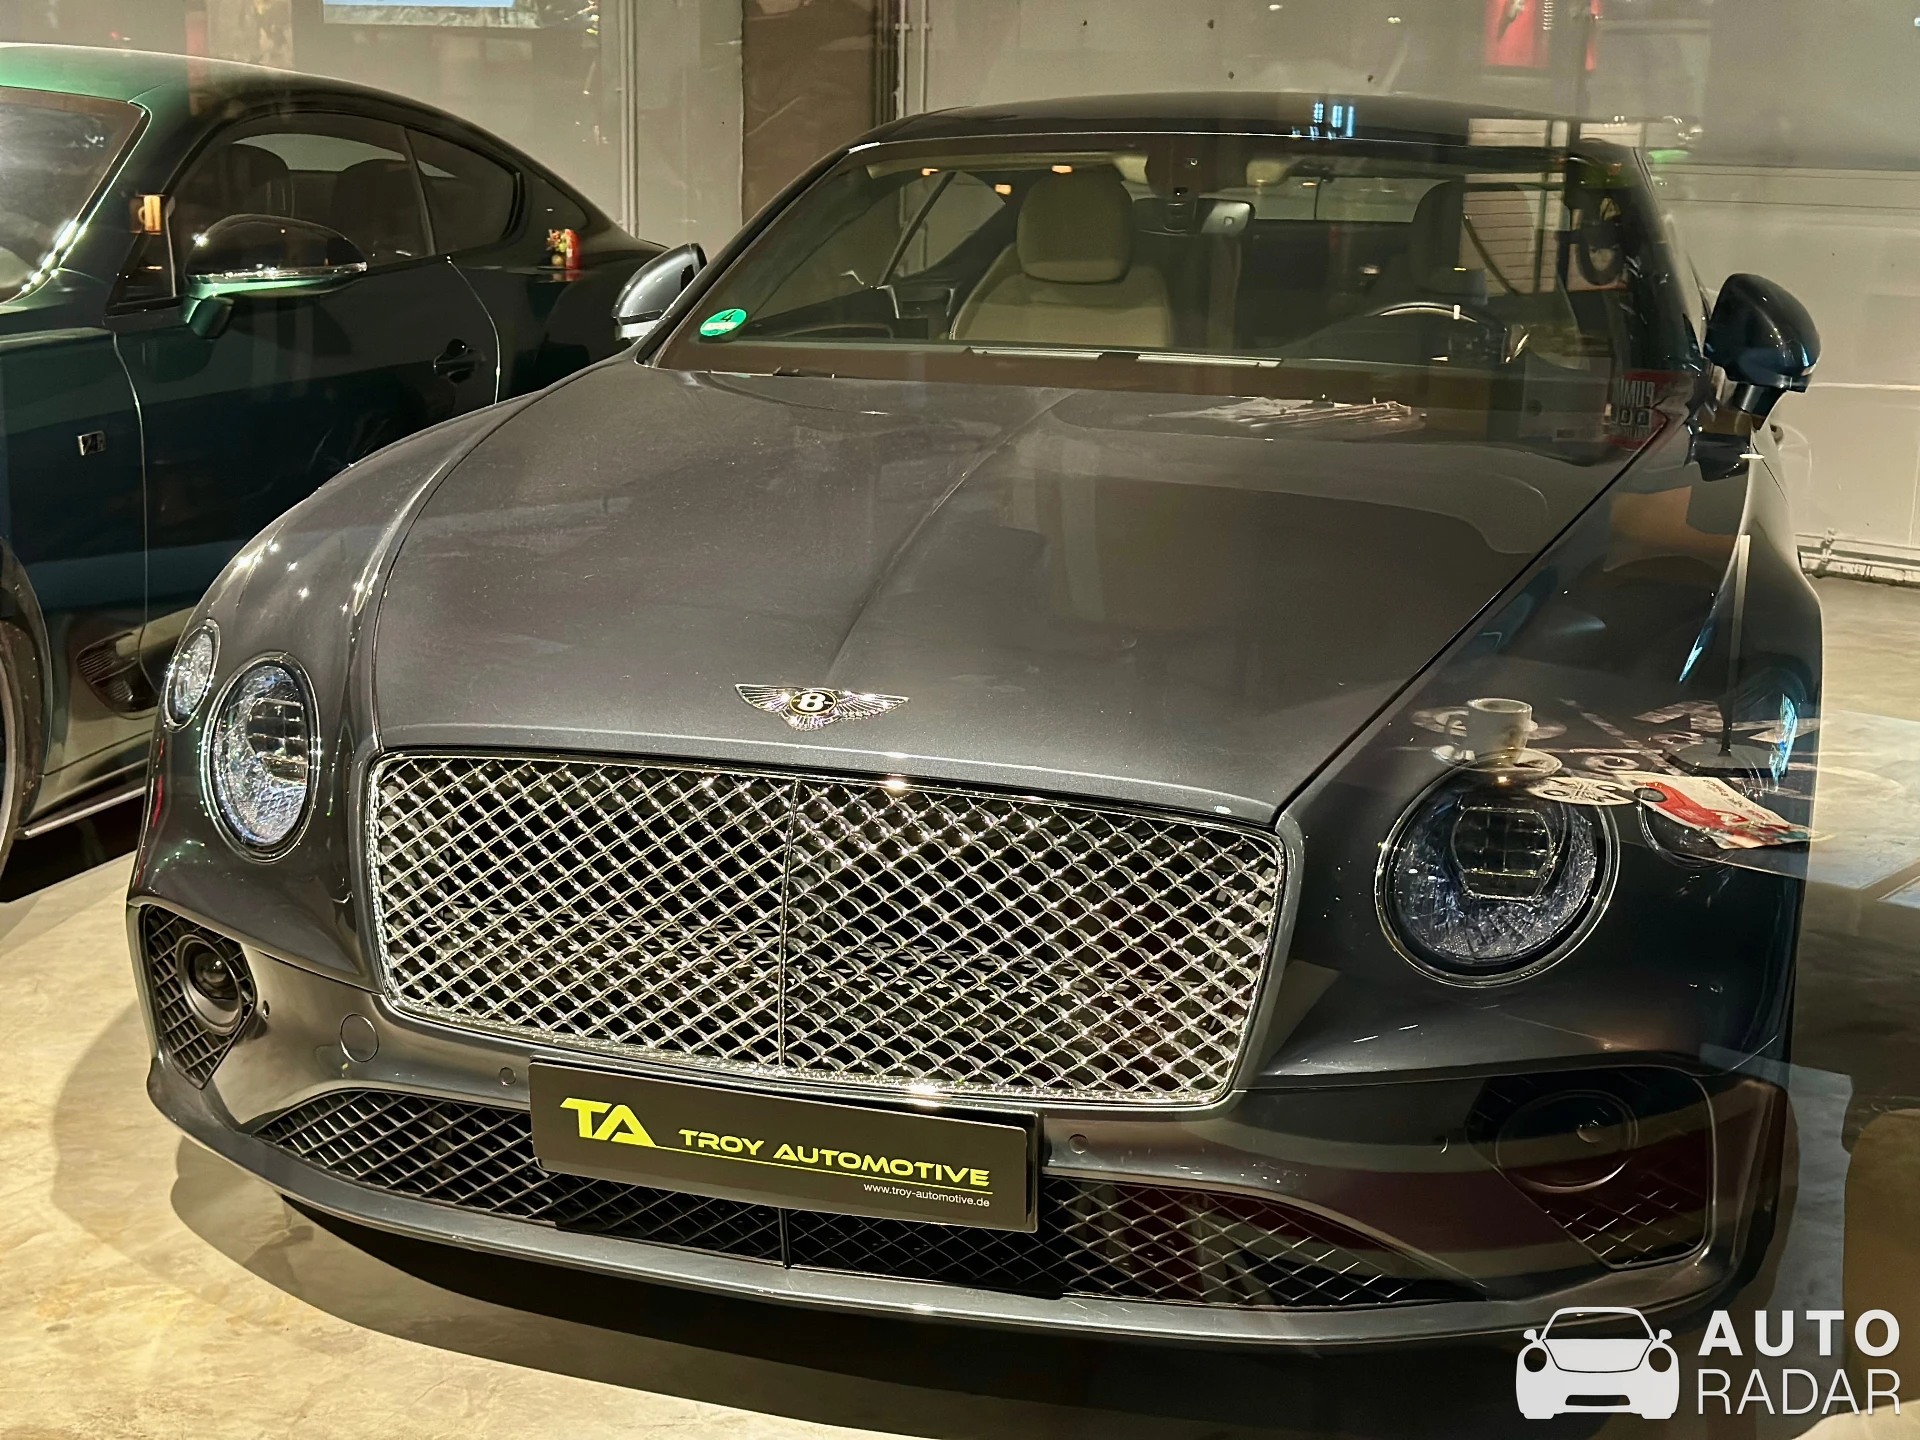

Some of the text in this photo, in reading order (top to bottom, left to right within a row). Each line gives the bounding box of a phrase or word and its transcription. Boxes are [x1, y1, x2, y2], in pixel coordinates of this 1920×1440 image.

[721, 309, 736, 322] 4
[797, 693, 826, 711] B
[560, 1097, 656, 1148] TA
[679, 1128, 990, 1187] TROY AUTOMOTIVE
[863, 1182, 991, 1208] www.troy-automotive.de
